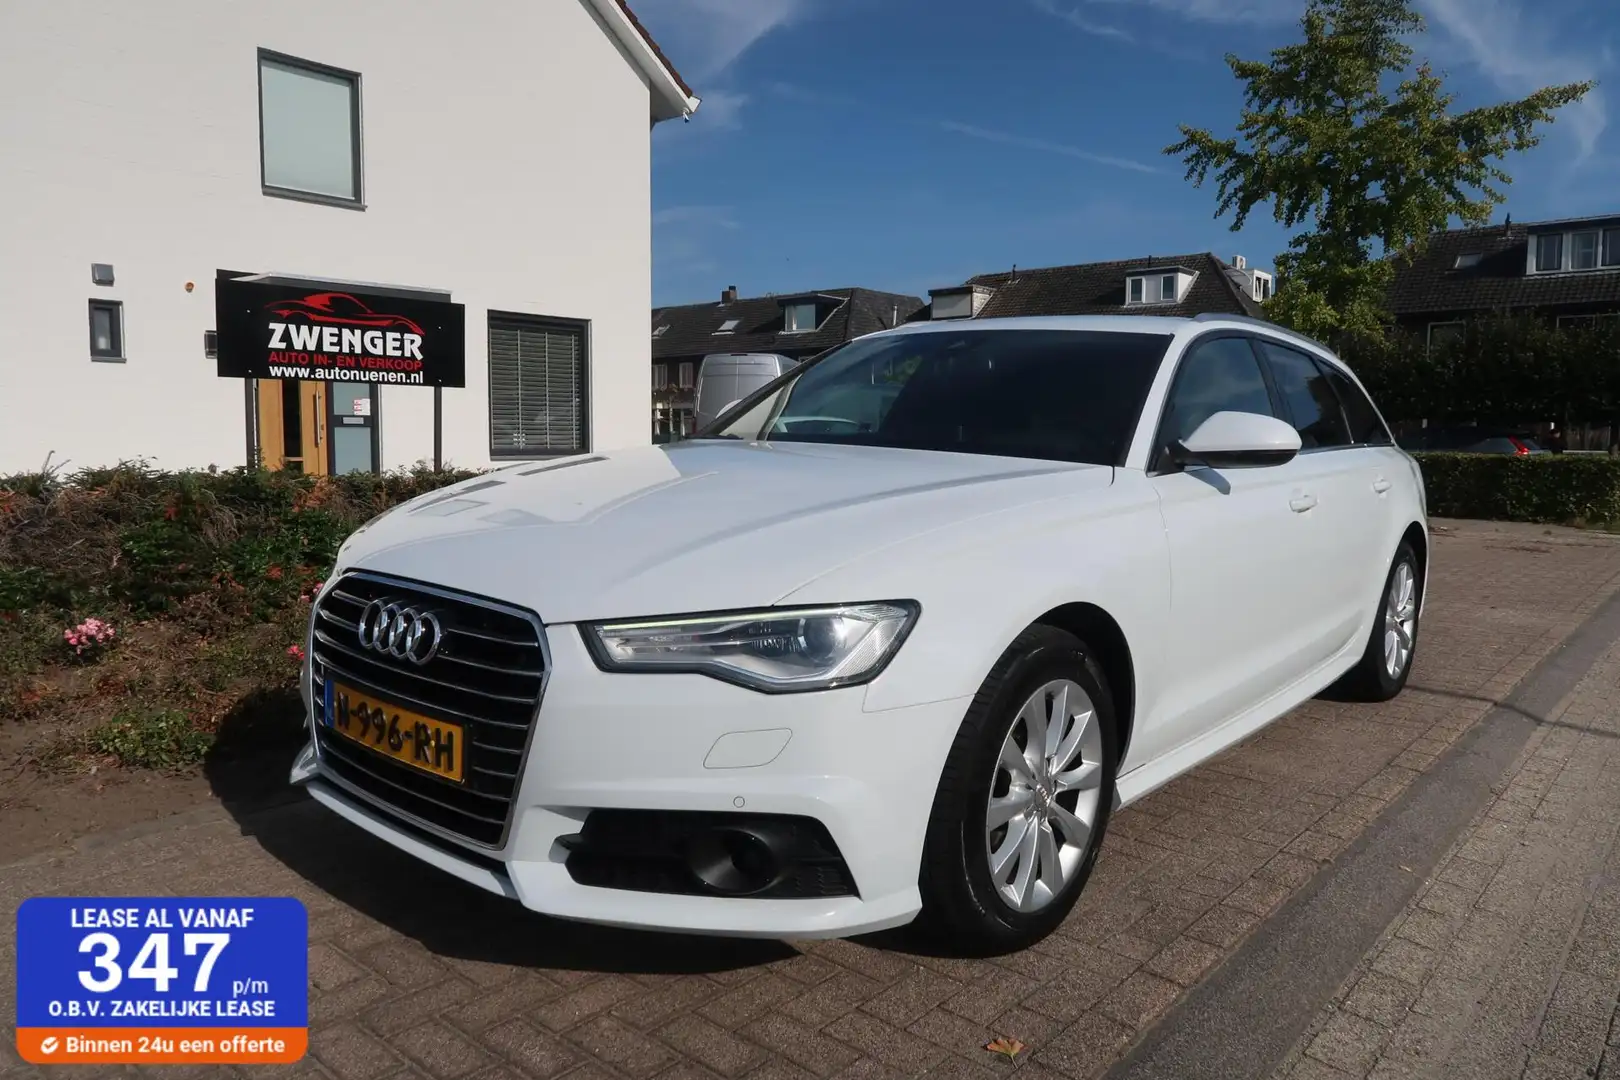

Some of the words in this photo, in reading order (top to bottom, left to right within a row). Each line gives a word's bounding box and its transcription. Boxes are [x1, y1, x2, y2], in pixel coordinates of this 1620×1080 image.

[268, 322, 424, 360] ZWENGER
[268, 351, 309, 364] AUTO
[313, 352, 333, 365] IN-
[336, 355, 356, 367] EN
[359, 357, 423, 371] VERKOOP
[268, 365, 424, 384] www.autonuenen.nl
[336, 691, 454, 772] N-996-RH
